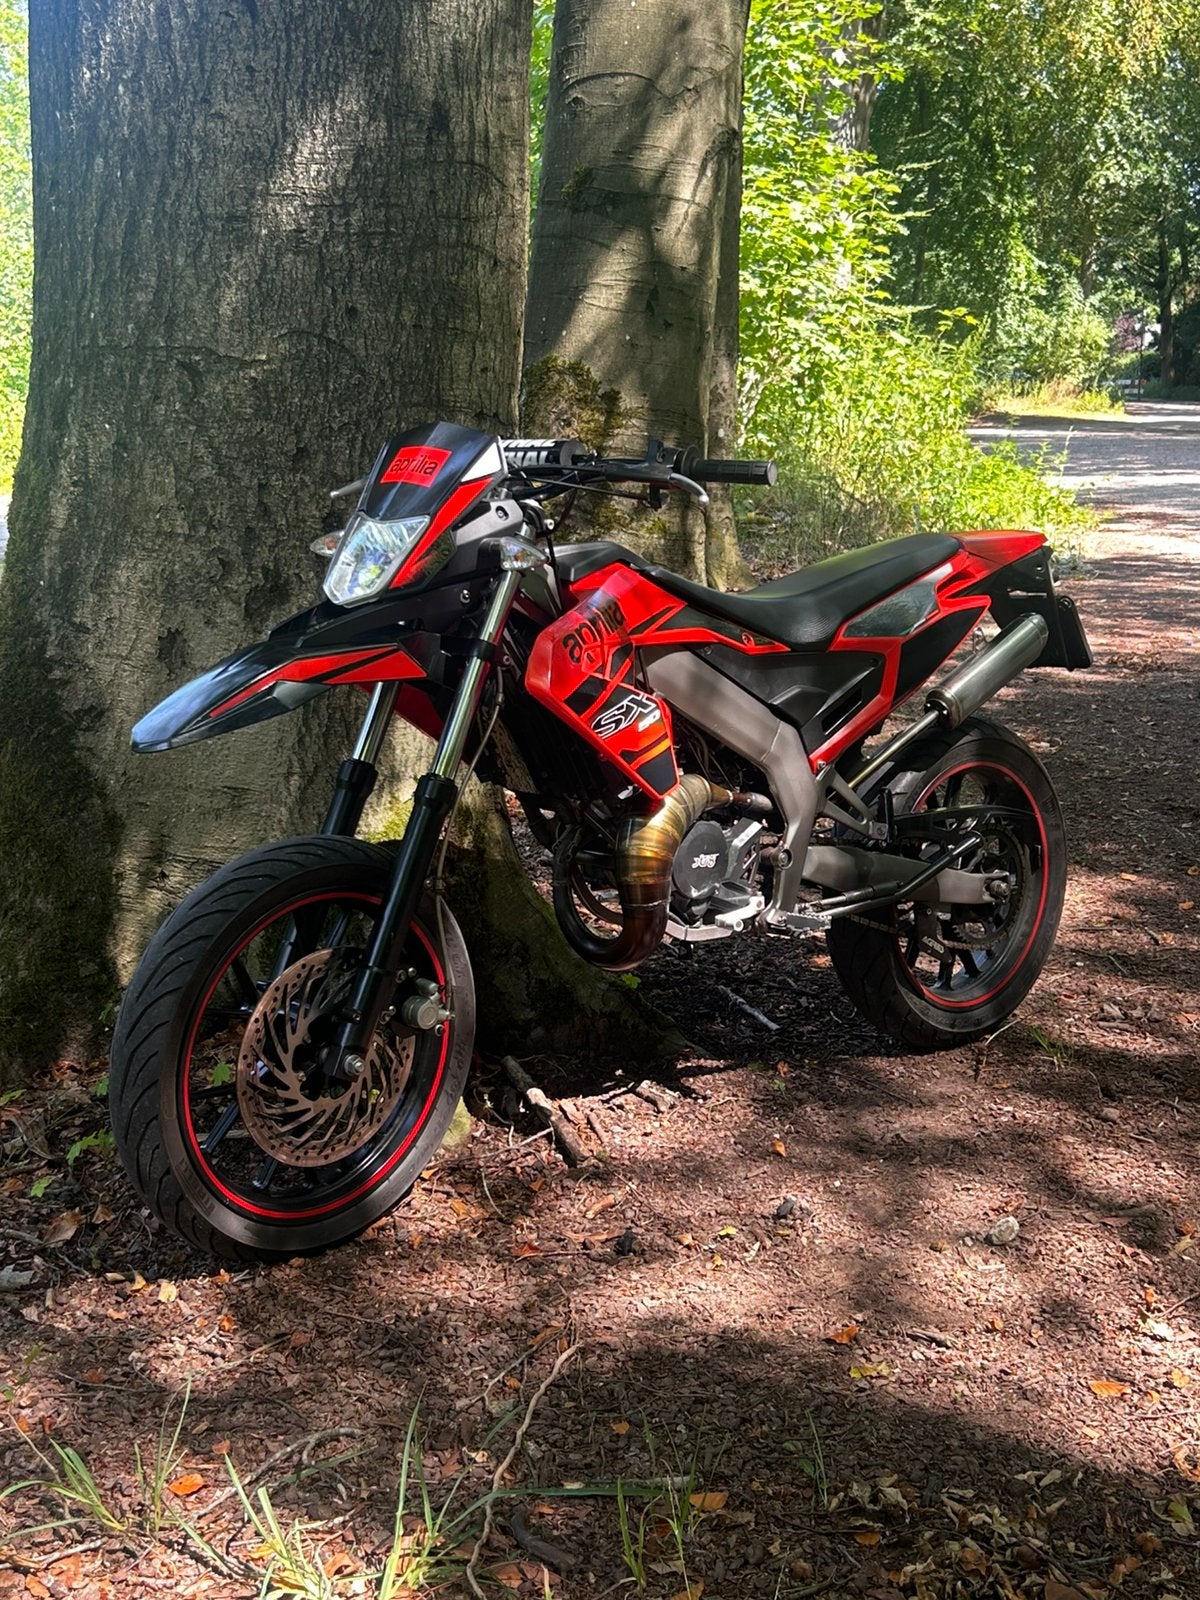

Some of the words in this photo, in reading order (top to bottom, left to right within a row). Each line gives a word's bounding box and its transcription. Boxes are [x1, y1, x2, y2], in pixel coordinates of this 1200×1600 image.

[390, 454, 439, 476] aprilia
[562, 599, 626, 664] aprilia
[591, 693, 657, 740] SX
